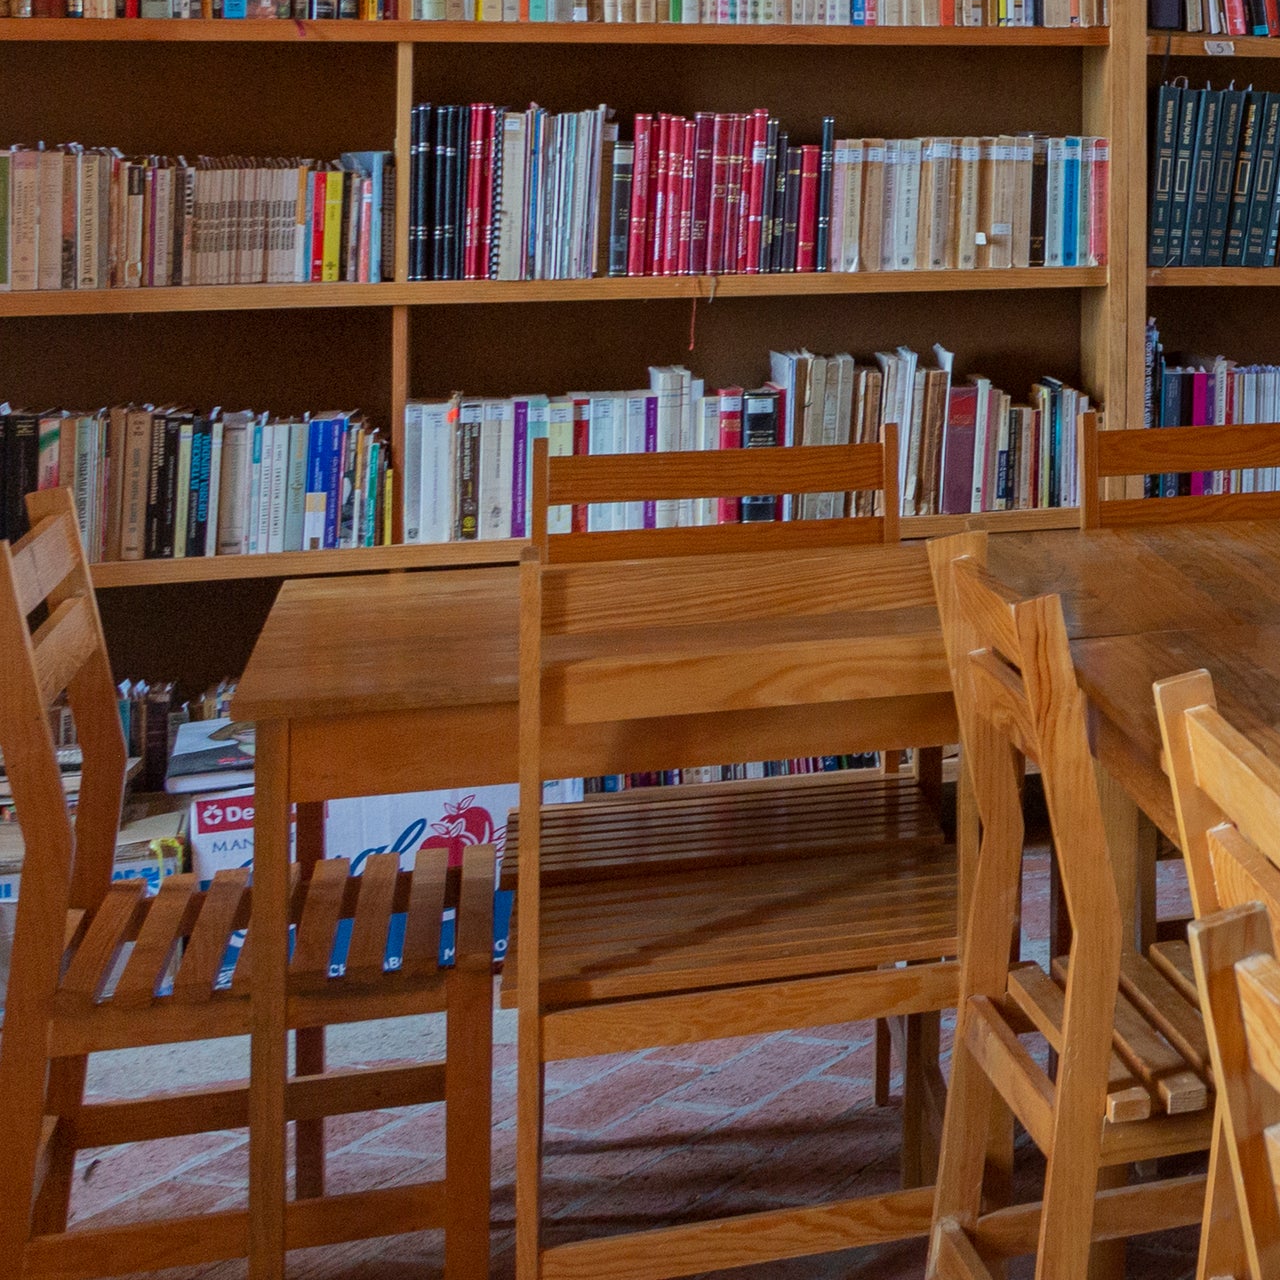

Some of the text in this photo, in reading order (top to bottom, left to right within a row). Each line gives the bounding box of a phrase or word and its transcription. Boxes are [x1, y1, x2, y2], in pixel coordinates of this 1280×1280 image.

[192, 433, 202, 478] TERCERA
[198, 435, 209, 521] GUERRA MUNDIAL
